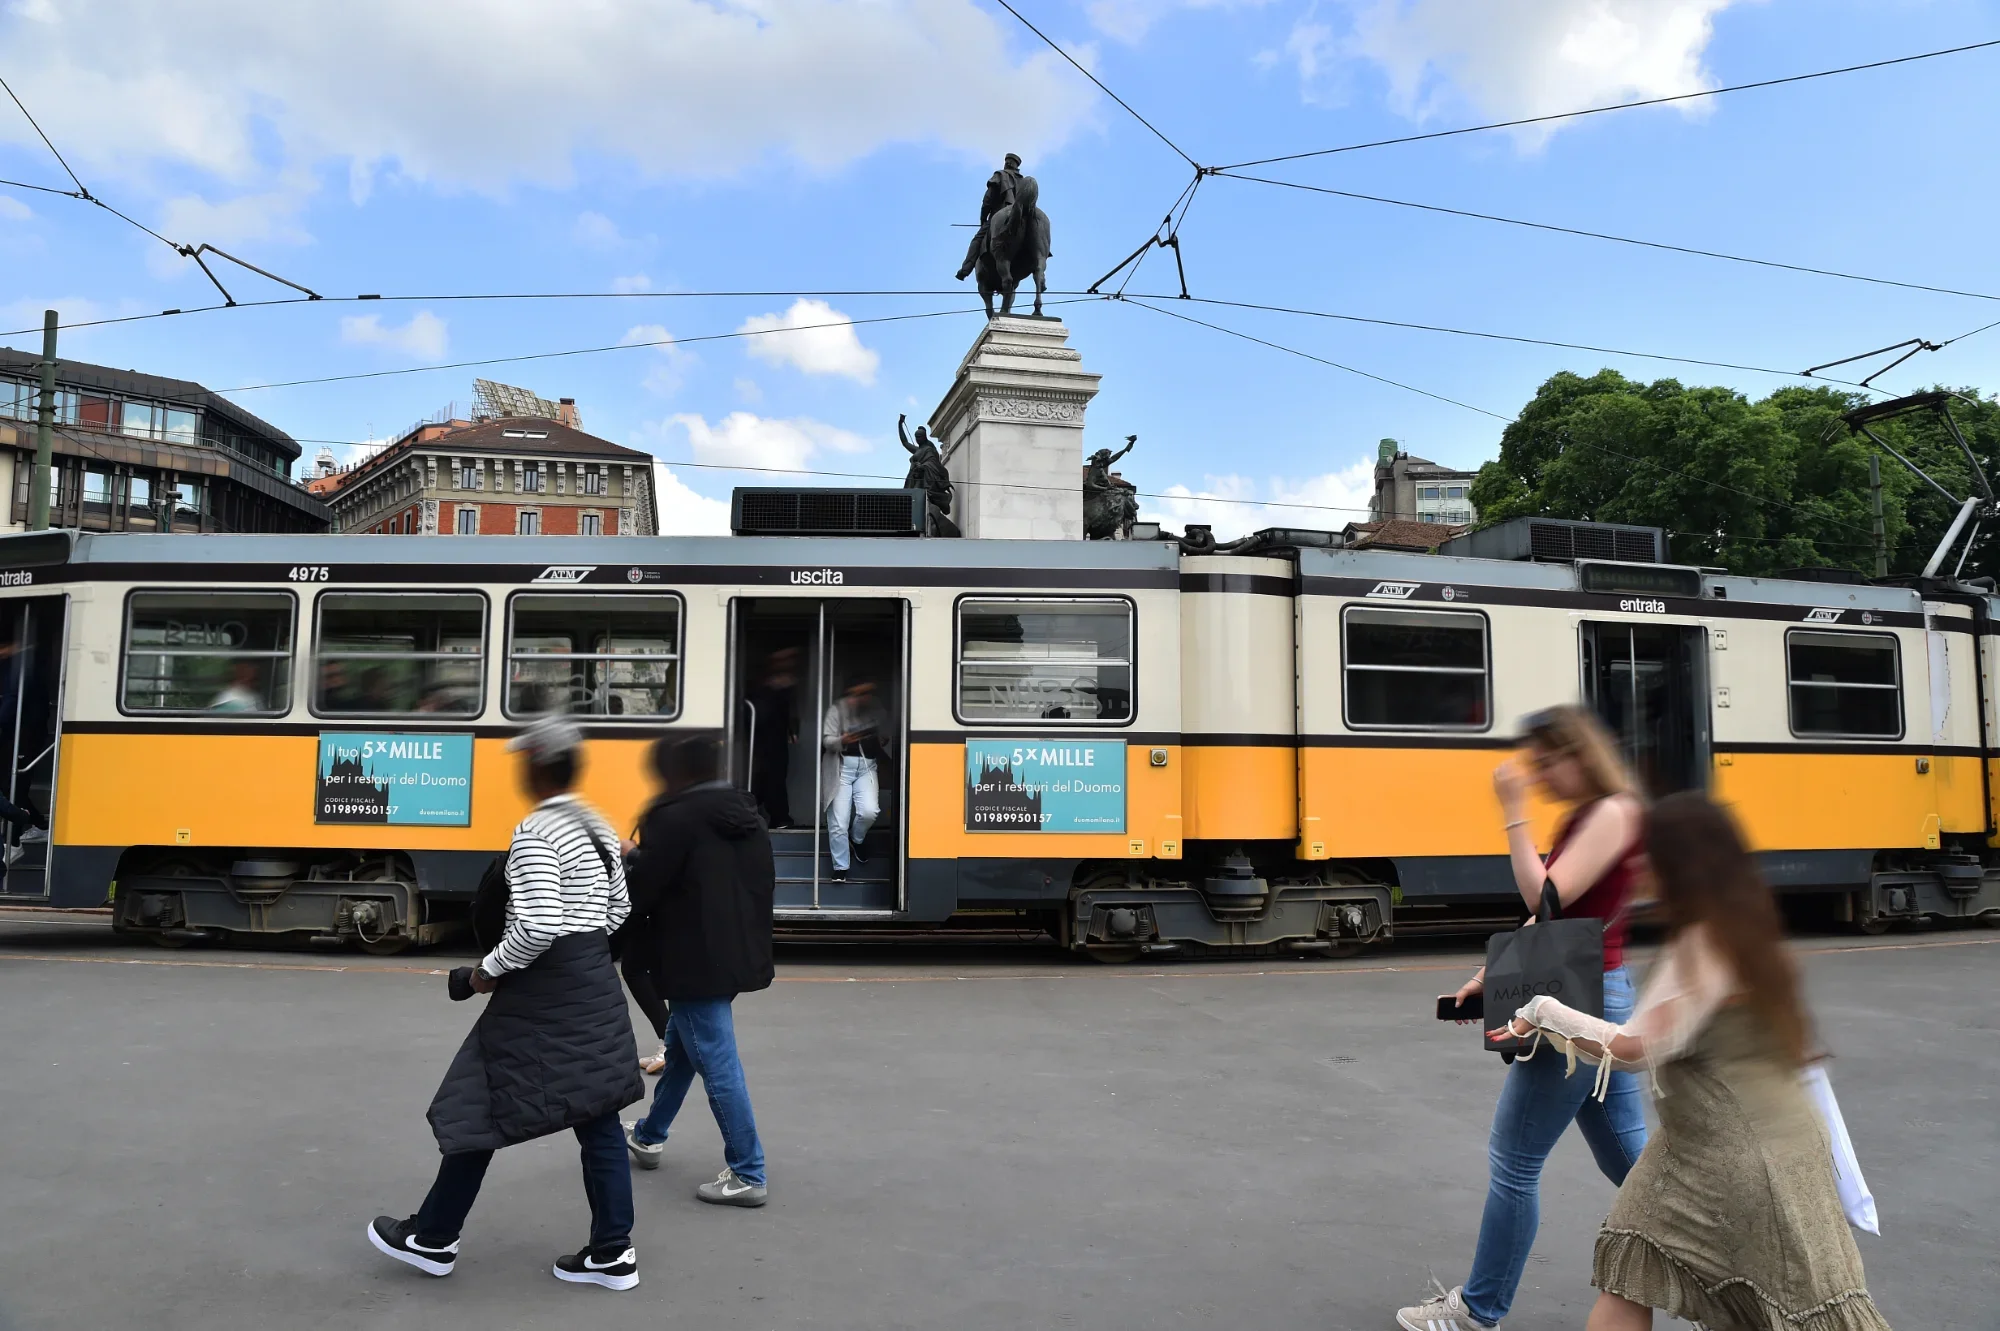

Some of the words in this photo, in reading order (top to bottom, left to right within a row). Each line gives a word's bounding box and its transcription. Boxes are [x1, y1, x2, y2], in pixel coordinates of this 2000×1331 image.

[0, 570, 33, 586] ntrata
[289, 567, 329, 581] 4975
[550, 570, 576, 579] ATM
[790, 568, 844, 585] uscita
[1382, 586, 1404, 595] ATM
[1619, 598, 1666, 614] entrata
[1815, 611, 1832, 620] ATM
[327, 744, 335, 757] Il
[338, 746, 359, 758] tuo
[975, 751, 983, 765] Il
[987, 753, 1008, 765] tuo
[325, 775, 345, 787] per
[348, 772, 352, 784] i
[354, 773, 396, 785] restauri
[399, 773, 418, 785] del
[421, 772, 467, 786] Duomo
[975, 782, 995, 795] per
[998, 780, 1002, 792] i
[1005, 781, 1049, 792] restauri
[1052, 780, 1071, 793] del
[1074, 780, 1121, 793] Duomo
[324, 804, 399, 815] 01989950157
[419, 808, 465, 816] duomomilano.it
[974, 812, 1053, 823] 01989950157
[1493, 979, 1563, 1002] MARCO
